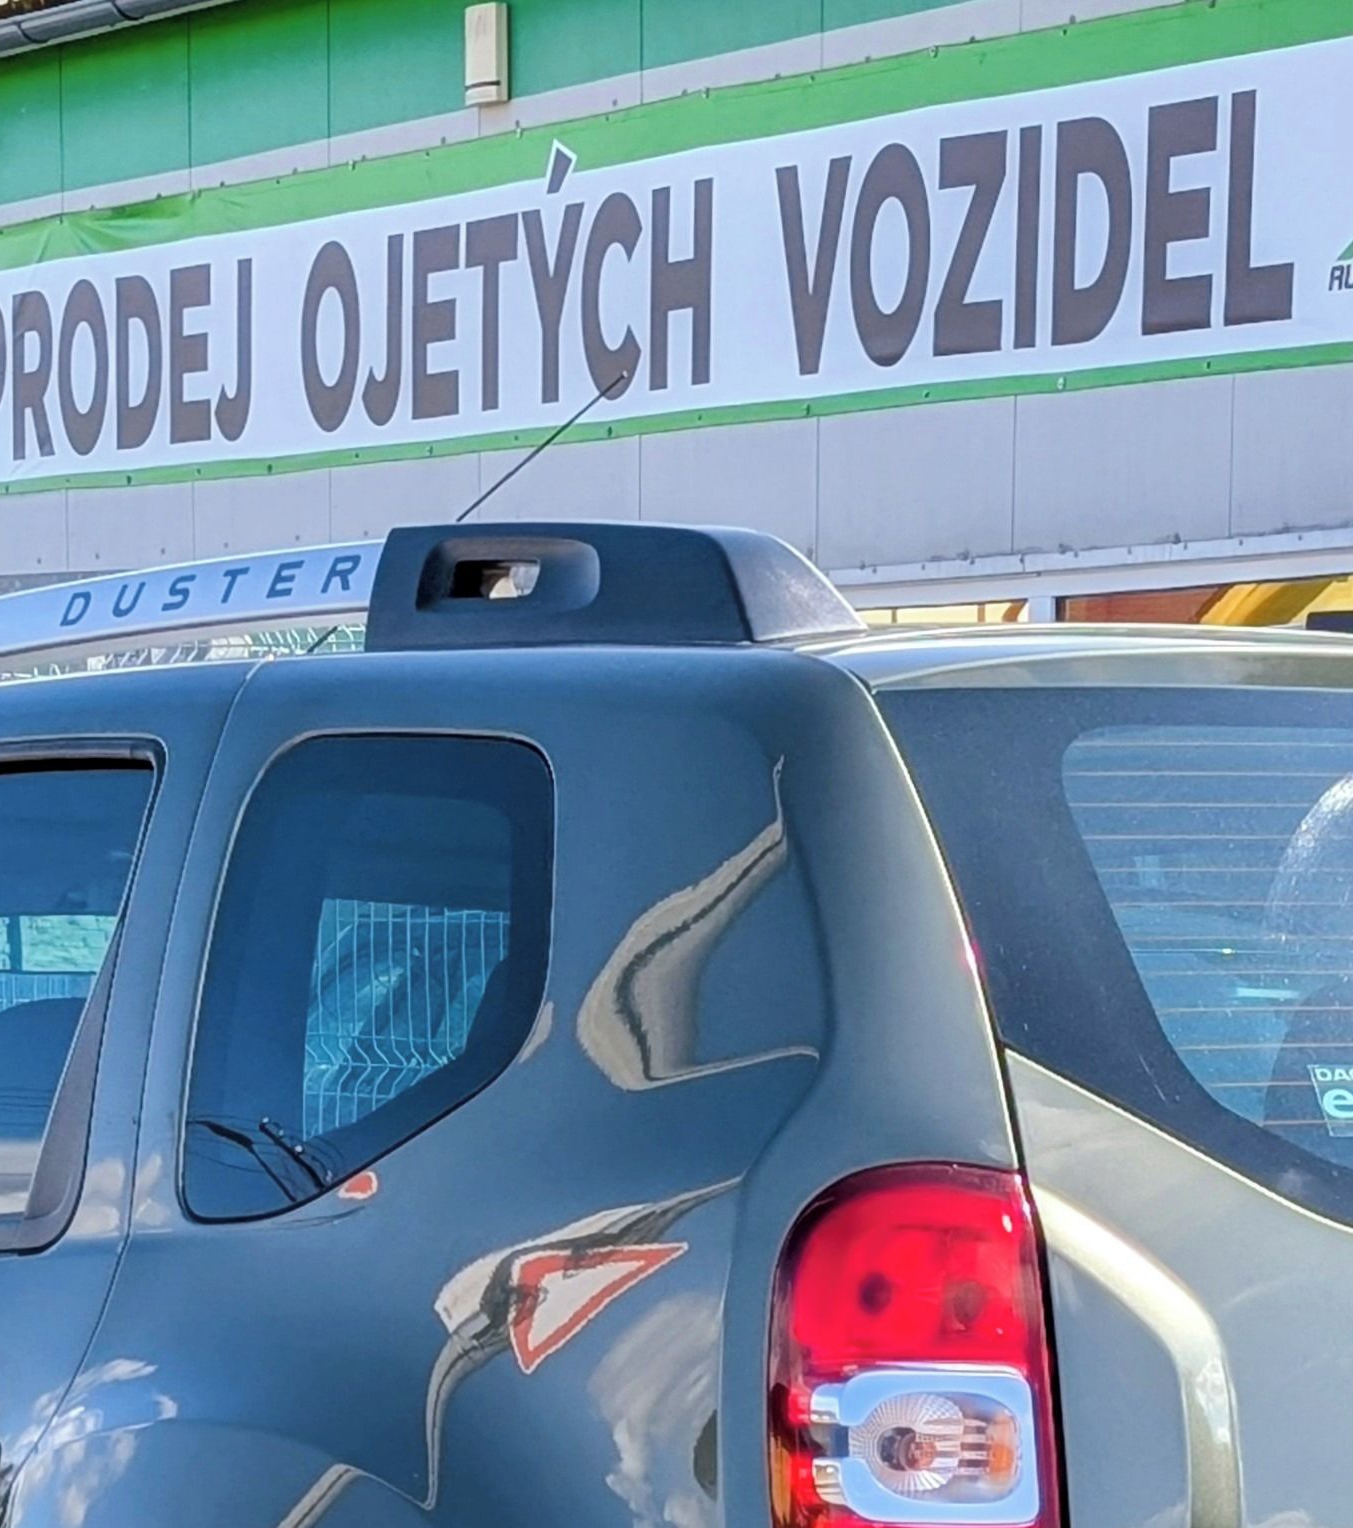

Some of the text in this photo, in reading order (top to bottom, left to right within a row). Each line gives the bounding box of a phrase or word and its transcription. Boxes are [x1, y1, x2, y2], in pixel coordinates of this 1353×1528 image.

[301, 141, 714, 432] OJETÝCH
[775, 88, 1294, 377] VOZIDEL
[59, 554, 362, 627] DUSTER
